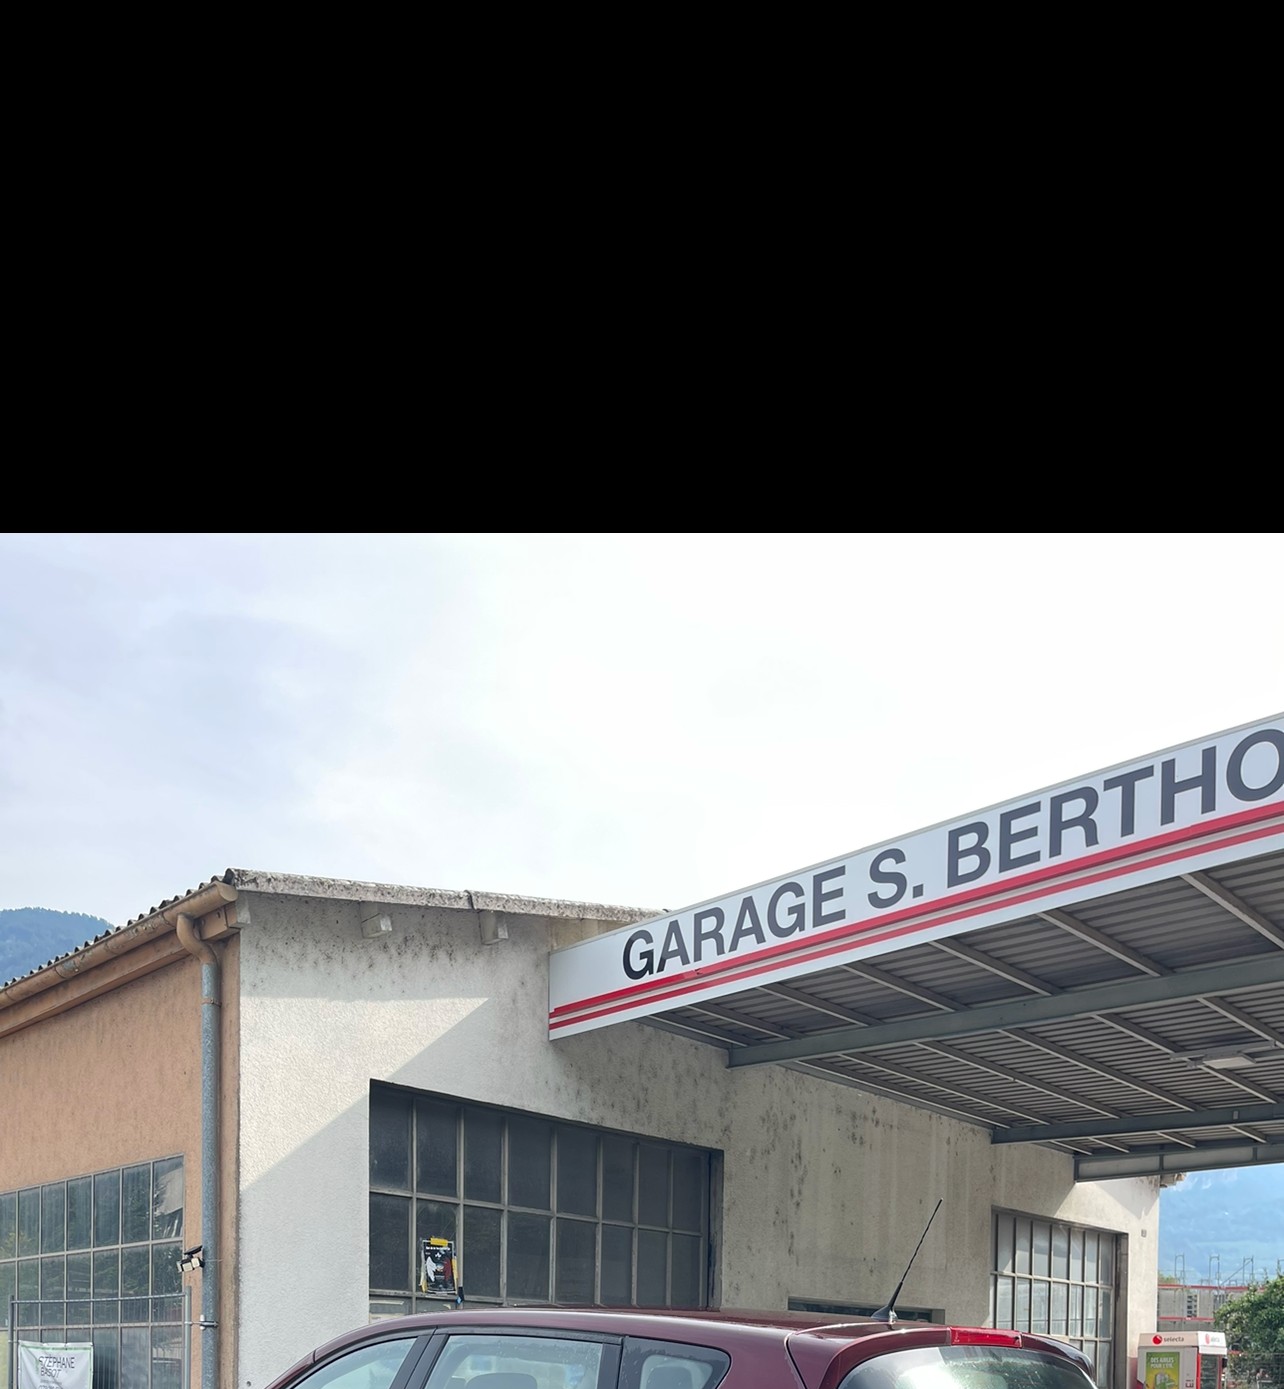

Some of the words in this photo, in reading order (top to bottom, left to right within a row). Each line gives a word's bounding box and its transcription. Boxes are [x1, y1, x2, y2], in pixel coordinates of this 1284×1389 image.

[622, 865, 846, 980] GARAGE
[867, 849, 924, 909] S.
[947, 728, 1284, 889] BERTHO
